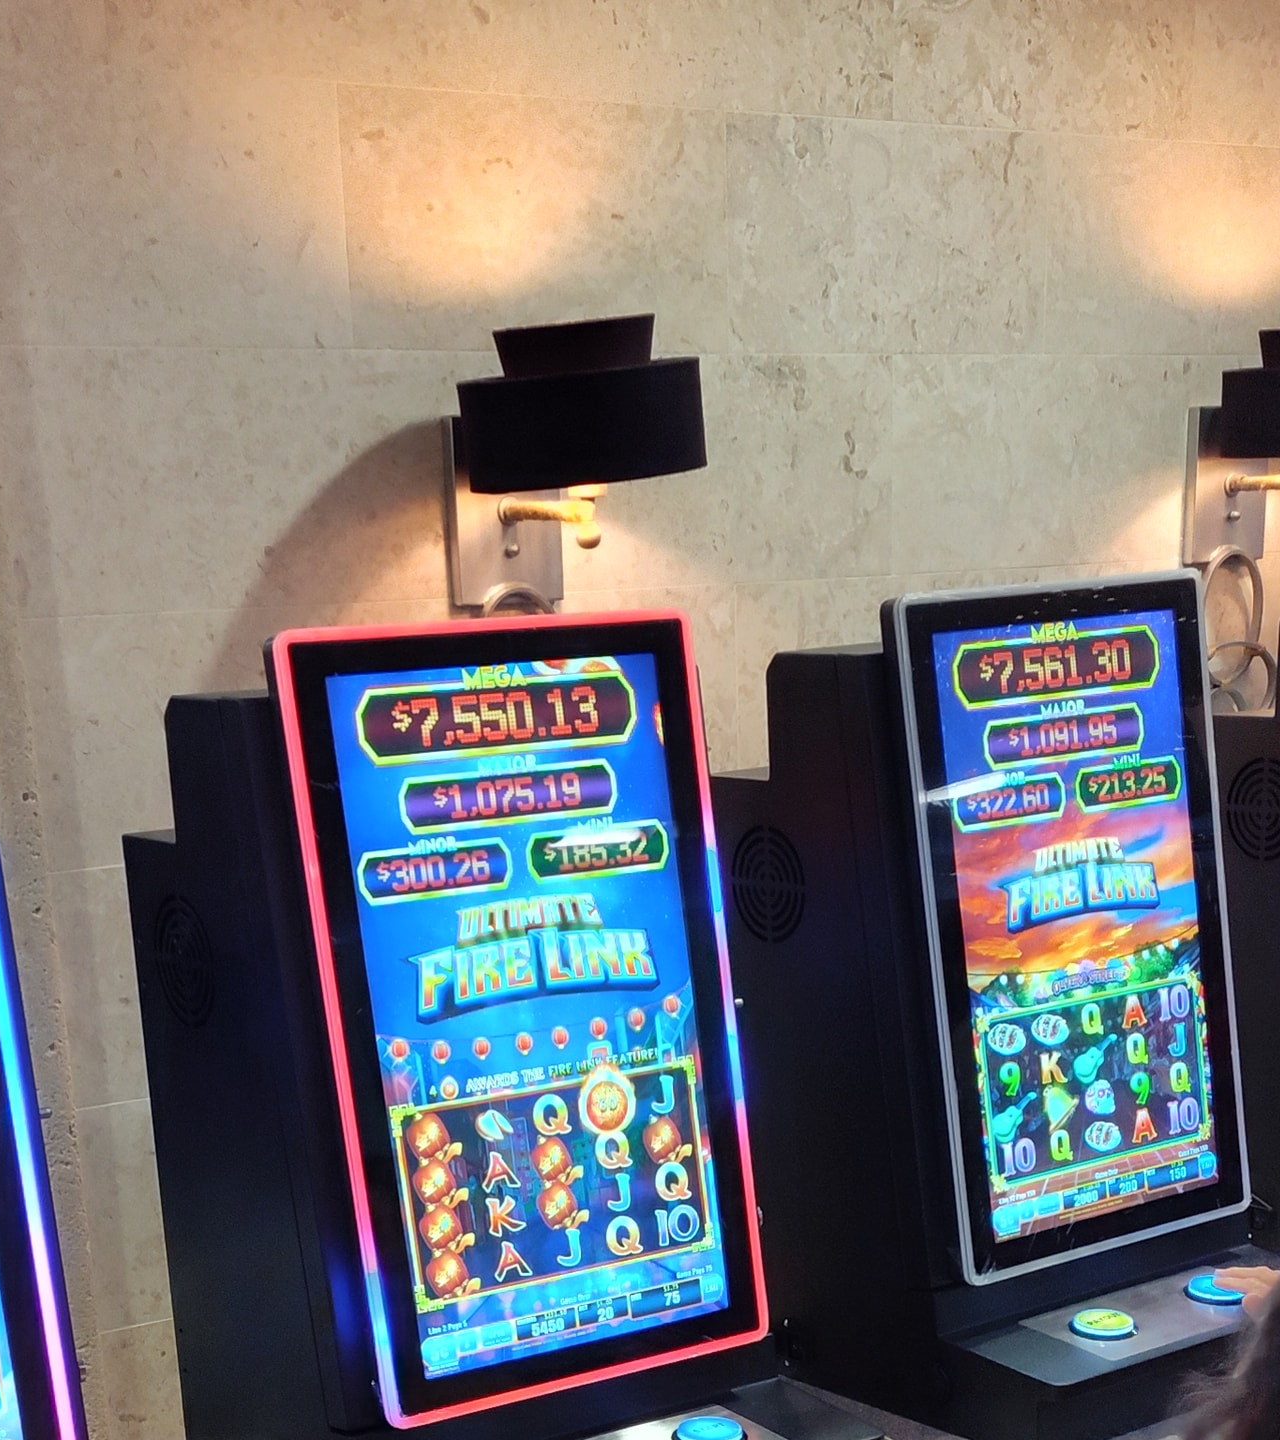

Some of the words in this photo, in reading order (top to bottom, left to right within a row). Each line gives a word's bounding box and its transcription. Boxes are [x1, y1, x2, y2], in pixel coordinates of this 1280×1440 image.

[1031, 621, 1078, 643] MEGA
[461, 665, 527, 690] MEGA
[979, 639, 1132, 693] $7,561.30
[391, 686, 599, 747] $7,550.13
[1040, 699, 1085, 717] MAJOR
[1008, 714, 1117, 755] $1,091.95
[478, 754, 537, 776] MAJOR
[1112, 754, 1141, 769] MINI
[433, 773, 581, 820] $1,075.19
[966, 784, 1049, 820] $322.60
[1088, 767, 1167, 802] $213.25
[577, 817, 614, 833] MINI
[408, 836, 457, 856] MINOR
[1032, 838, 1125, 872] ULTIMATE
[376, 851, 491, 892] $300.26
[1006, 872, 1082, 925] FIRE
[1087, 862, 1159, 903] LINK
[456, 893, 603, 940] ULTIMATE
[411, 939, 533, 1014] FIRE
[546, 930, 655, 981] LINK
[1080, 1002, 1104, 1036] Q
[1122, 994, 1147, 1029] A
[1159, 984, 1190, 1021] 10
[1126, 1032, 1149, 1064] Q
[1168, 1023, 1188, 1057] J
[466, 1072, 519, 1092] AWARDS
[521, 1067, 545, 1083] THE
[548, 1062, 572, 1075] FIRE
[576, 1057, 604, 1073] LINK
[999, 1062, 1021, 1097] 9
[1039, 1051, 1068, 1085] K
[1170, 1062, 1193, 1093] Q
[430, 1086, 437, 1097] 4
[651, 1075, 674, 1115] J
[1129, 1071, 1151, 1106] 9
[532, 1094, 572, 1137] Q
[1132, 1107, 1158, 1143] A
[1167, 1097, 1200, 1135] 10
[594, 1130, 632, 1169] Q
[1001, 1137, 1037, 1176] 10
[1049, 1129, 1074, 1162] Q
[482, 1152, 521, 1193] A
[655, 1161, 691, 1201] Q
[1120, 1180, 1137, 1194] 200
[1169, 1166, 1187, 1181] 150
[608, 1172, 630, 1211] J
[1074, 1190, 1098, 1207] 2000
[485, 1196, 526, 1237] K
[655, 1204, 700, 1247] 10
[557, 1229, 581, 1267] J
[606, 1216, 643, 1256] Q
[494, 1241, 532, 1282] A
[597, 1306, 614, 1322] 20
[664, 1291, 681, 1306] 75
[531, 1318, 565, 1336] 5450
